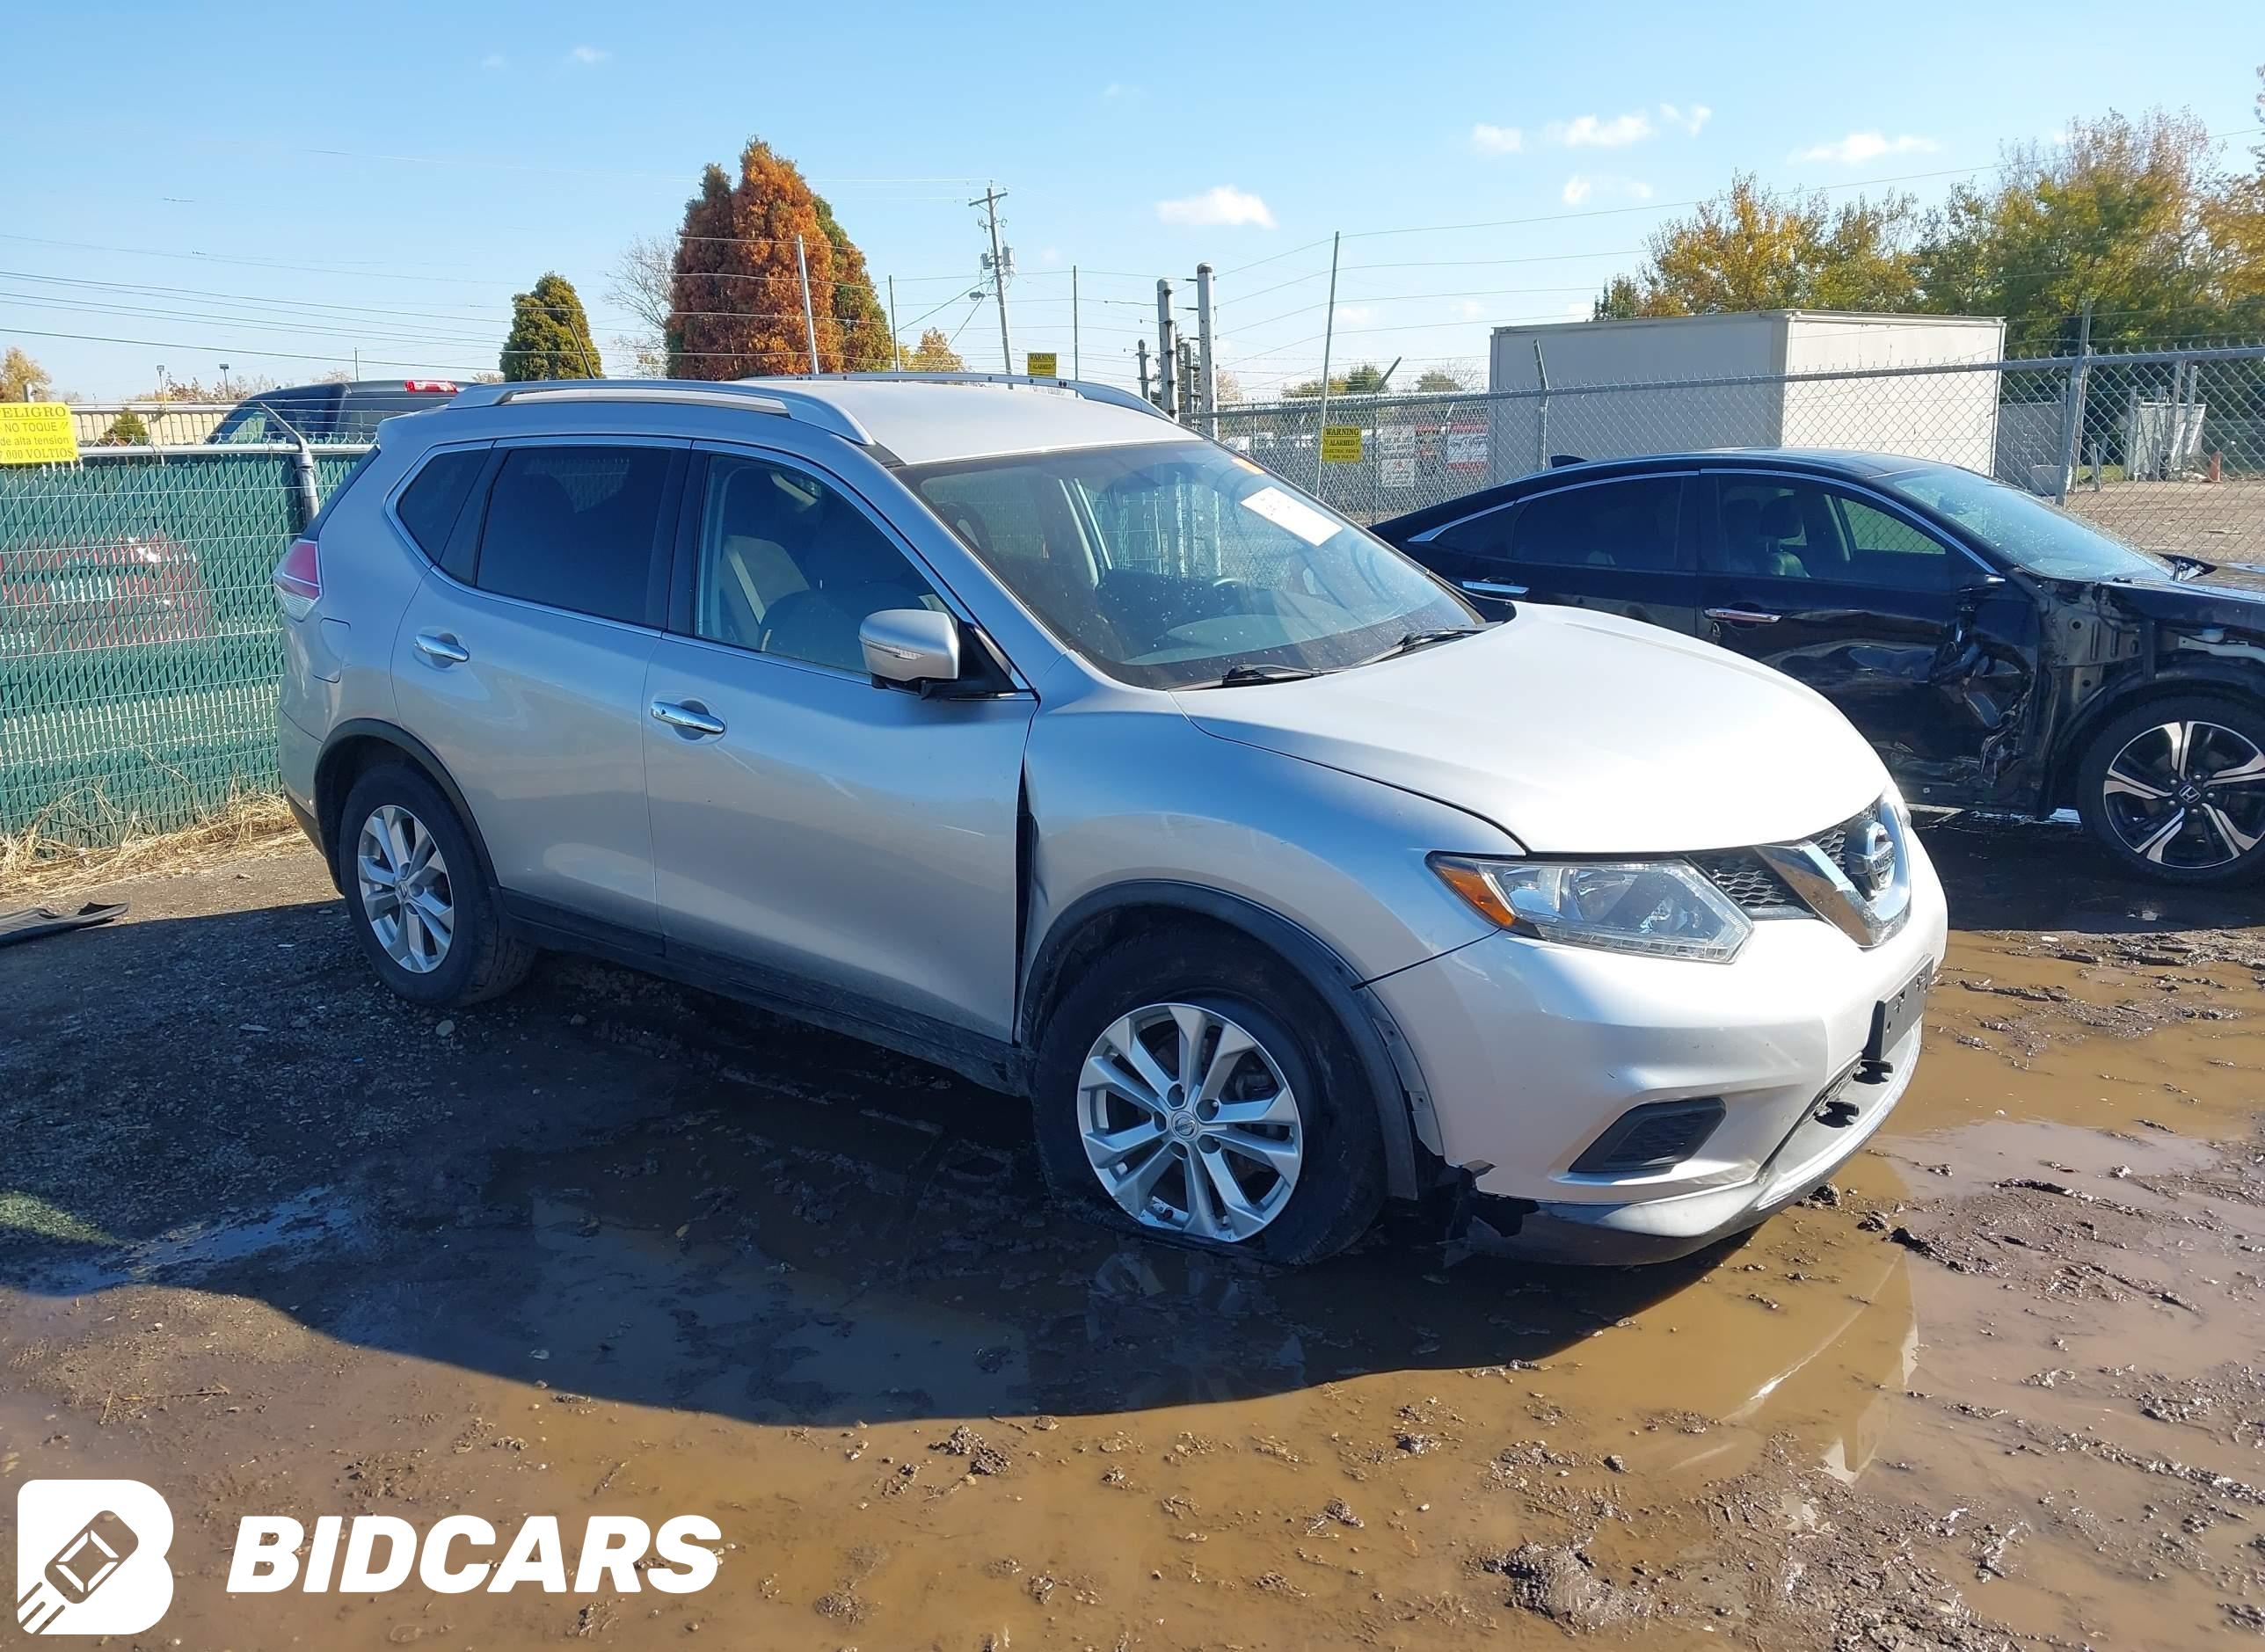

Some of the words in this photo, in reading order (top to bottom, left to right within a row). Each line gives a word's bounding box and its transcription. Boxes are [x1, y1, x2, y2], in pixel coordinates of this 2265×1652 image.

[0, 406, 66, 418] ELIGRO
[4, 422, 19, 433] NO
[21, 421, 57, 432] TOQUE
[0, 437, 11, 447] de
[14, 436, 32, 446] alta
[34, 435, 69, 445] tension
[25, 448, 74, 458] VOLTIOS
